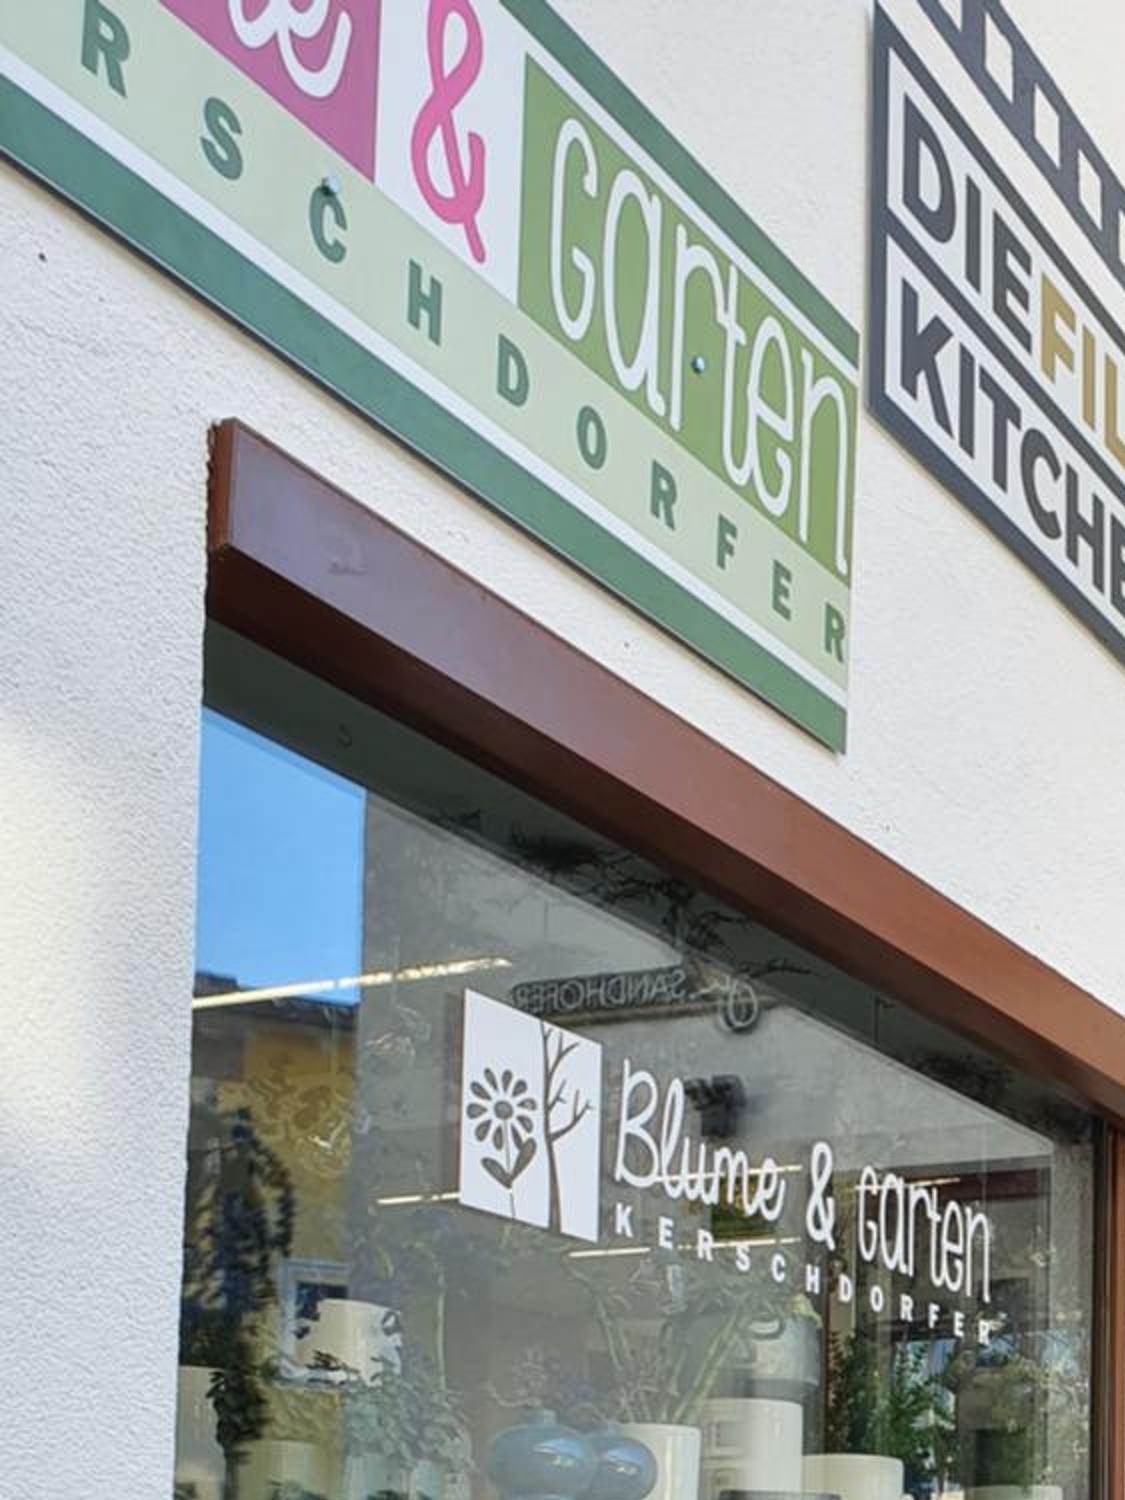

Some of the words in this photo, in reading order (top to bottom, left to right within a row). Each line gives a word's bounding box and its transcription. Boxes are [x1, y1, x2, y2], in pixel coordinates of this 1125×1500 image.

[411, 0, 486, 264] &
[550, 118, 848, 576] Garten
[613, 1058, 787, 1222] Blume
[805, 1140, 837, 1251] &
[613, 1202, 994, 1344] KERSCHDORFER
